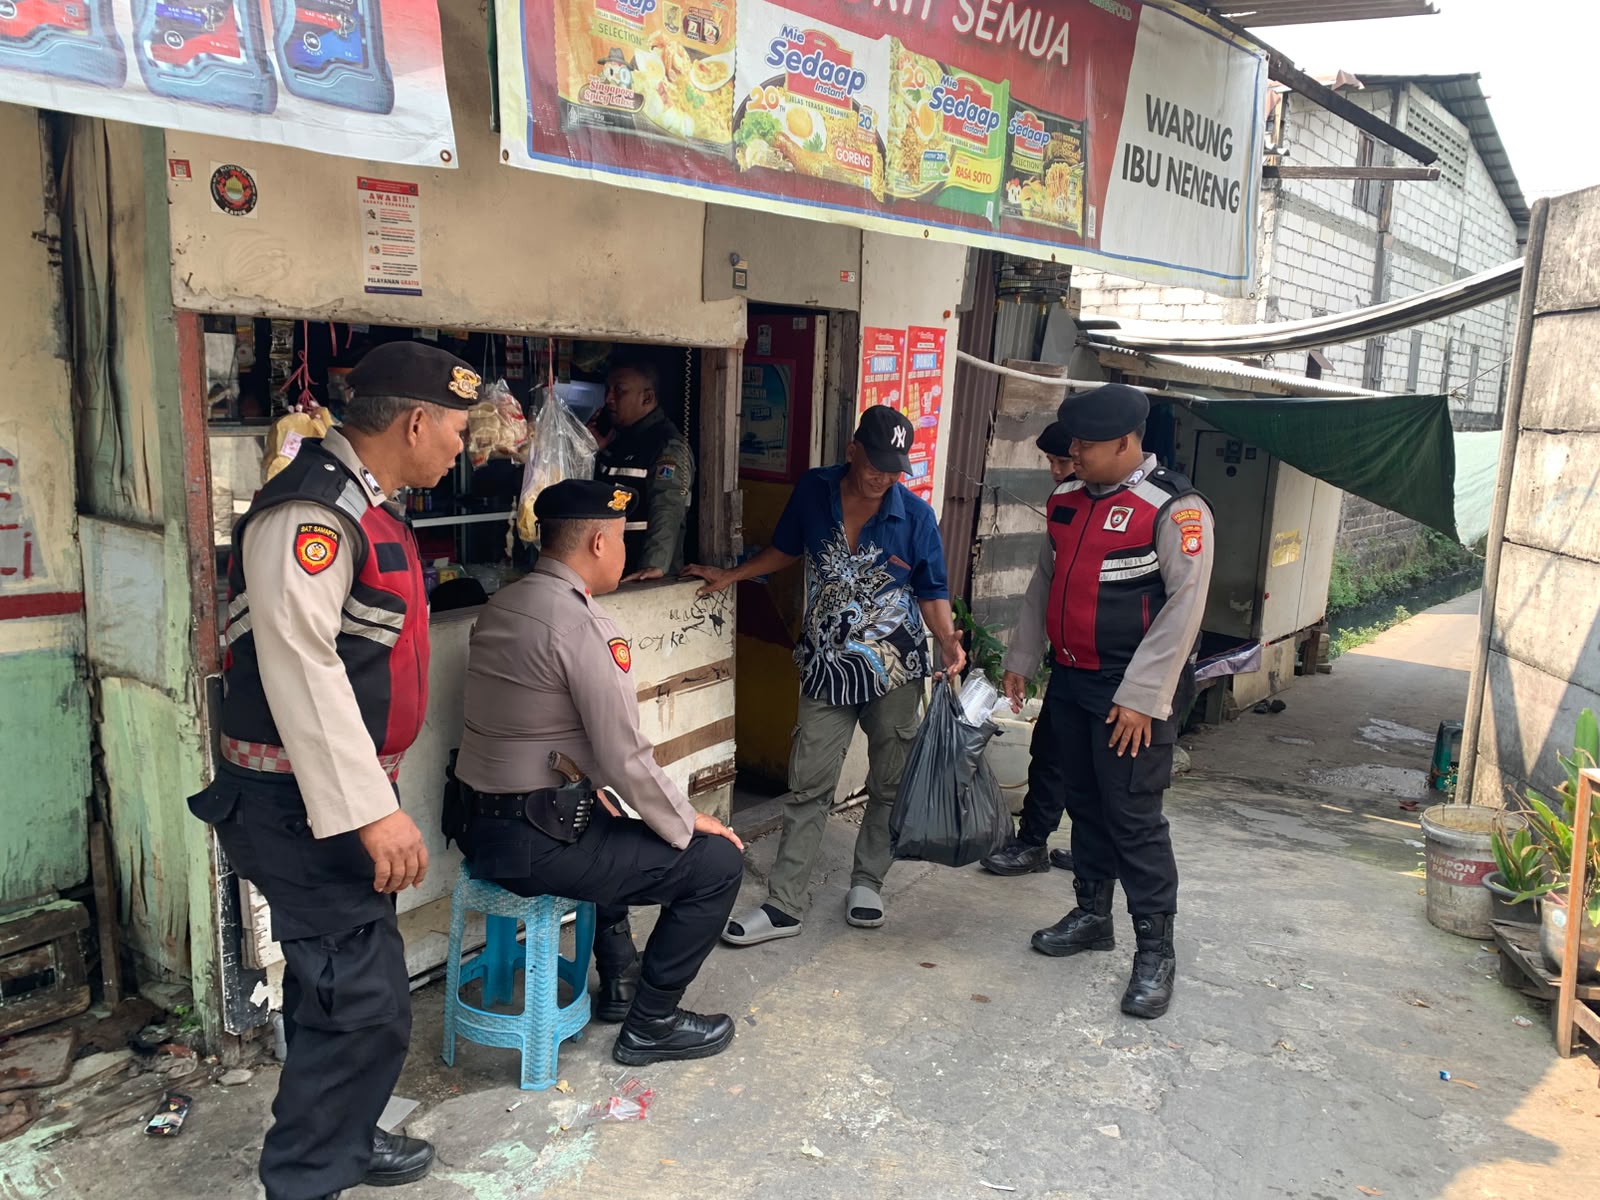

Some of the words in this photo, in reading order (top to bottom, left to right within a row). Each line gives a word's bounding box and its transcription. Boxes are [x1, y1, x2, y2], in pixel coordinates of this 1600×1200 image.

[598, 22, 642, 46] SELECTION
[781, 25, 805, 43] Mie
[952, 0, 1069, 65] SEMUA
[766, 38, 866, 96] Sedaap
[814, 83, 846, 99] Instant
[940, 75, 958, 90] Mie
[929, 87, 1000, 132] Sedaap
[1008, 118, 1050, 146] Sedaap
[1145, 93, 1233, 161] WARUNG
[835, 147, 871, 168] GORENG
[955, 166, 972, 181] RASA
[972, 170, 993, 185] SOTO
[1122, 143, 1162, 188] IBU
[1165, 156, 1240, 214] NENENG
[1432, 863, 1467, 881] PAINT
